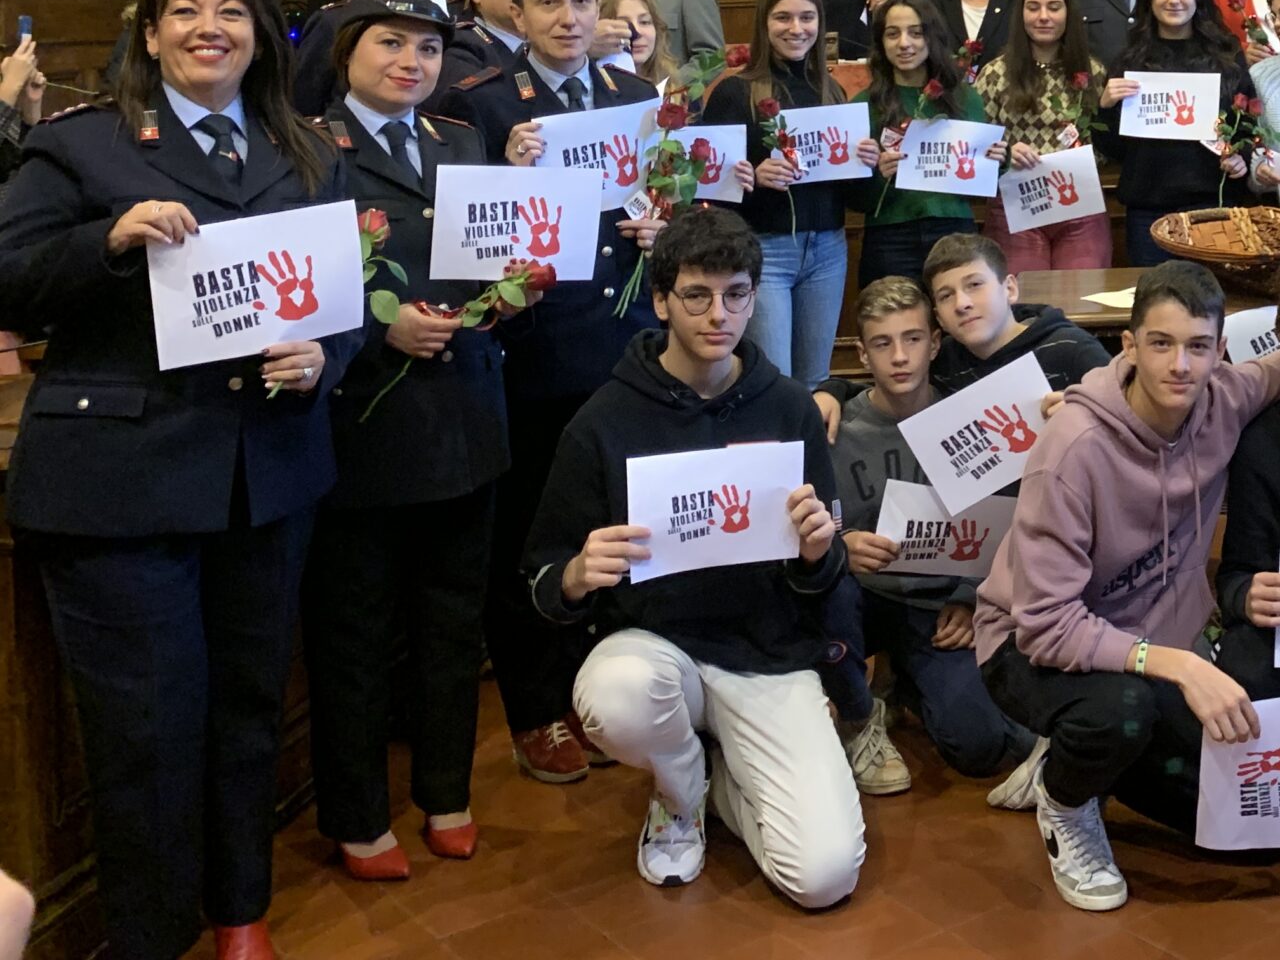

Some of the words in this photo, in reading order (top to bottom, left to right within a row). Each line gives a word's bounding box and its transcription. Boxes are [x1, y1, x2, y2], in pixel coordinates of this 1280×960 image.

[1141, 92, 1170, 105] BASTA
[797, 130, 822, 147] ASTA
[920, 141, 951, 155] BASTA
[562, 141, 607, 168] BASTA
[1018, 175, 1050, 196] BASTA
[468, 201, 520, 223] BASTA
[465, 221, 517, 241] VIOLENZA
[476, 244, 514, 260] DONNE
[192, 260, 260, 298] BASTA
[193, 285, 260, 317] VIOLENZA
[213, 312, 261, 338] DONNE
[941, 419, 987, 456] BASTA
[951, 437, 992, 470] VIOLENZA
[971, 454, 1002, 480] DONNE
[672, 490, 715, 514] BASTA
[670, 508, 713, 528] VIOLENZA
[680, 526, 710, 542] DONNE
[906, 520, 952, 538] BASTA
[900, 539, 946, 551] VIOLENZA
[905, 552, 938, 560] DONNE
[1240, 781, 1258, 817] BASTA
[1258, 781, 1272, 817] VIOLENZA
